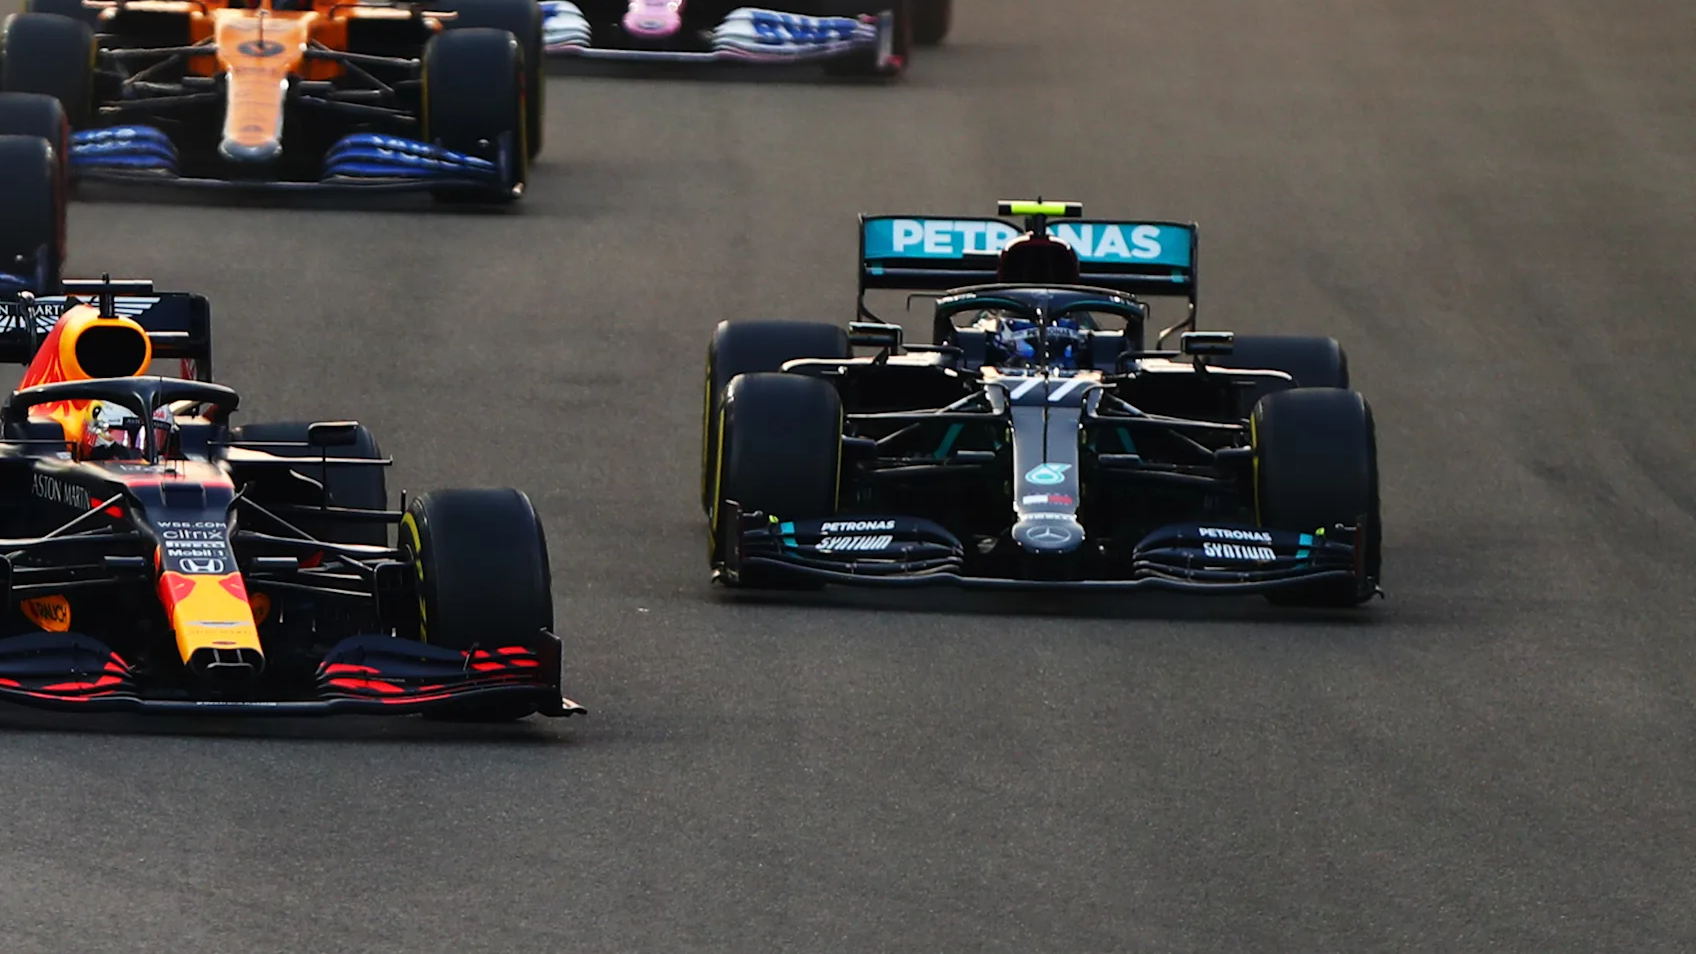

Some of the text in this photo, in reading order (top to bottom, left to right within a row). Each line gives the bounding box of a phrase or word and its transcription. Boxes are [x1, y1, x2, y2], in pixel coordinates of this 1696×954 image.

[32, 473, 91, 510] ASTON MARTIN
[821, 520, 896, 532] PETRONAS
[163, 529, 223, 539] citrix
[1199, 528, 1272, 542] PETRONAS
[816, 534, 892, 550] SYNTIUM
[168, 549, 212, 557] Mobil
[1203, 542, 1277, 561] SYNTIUM
